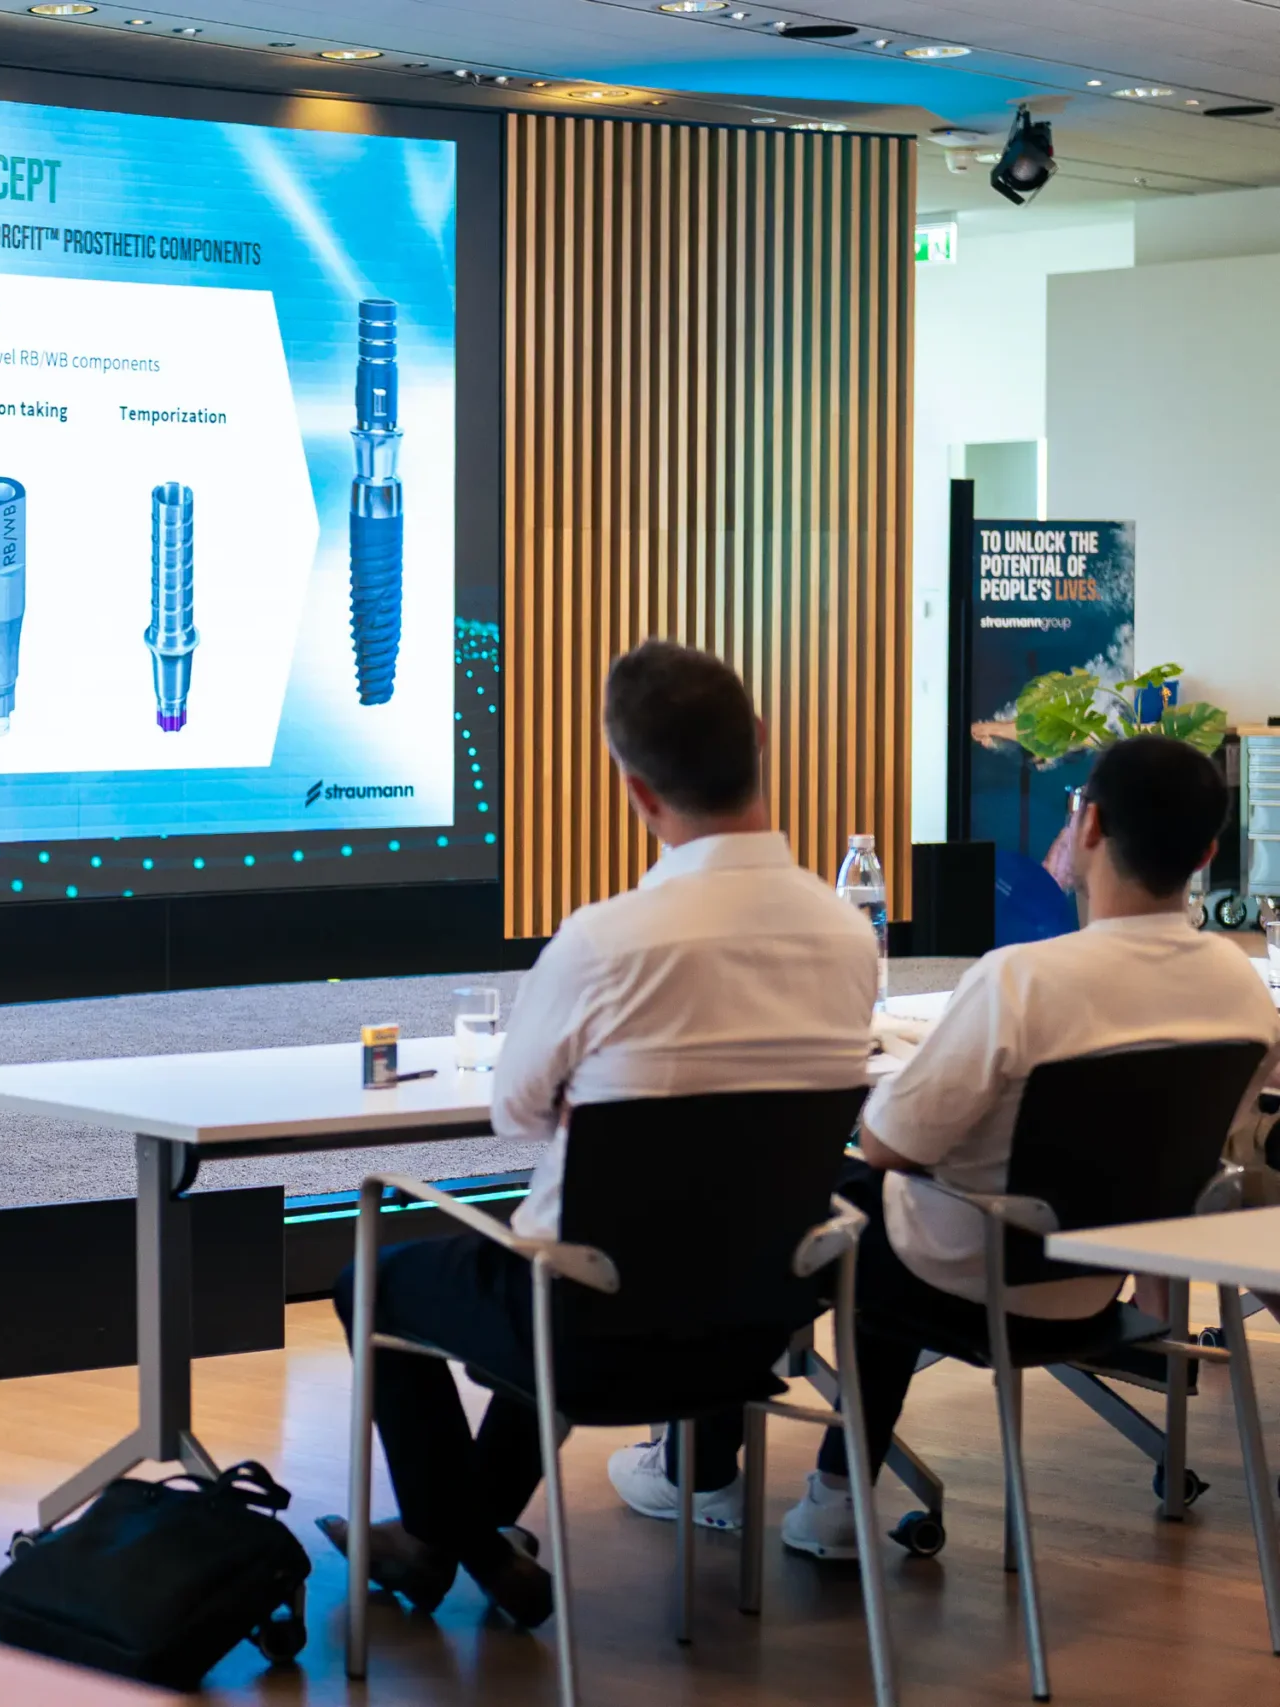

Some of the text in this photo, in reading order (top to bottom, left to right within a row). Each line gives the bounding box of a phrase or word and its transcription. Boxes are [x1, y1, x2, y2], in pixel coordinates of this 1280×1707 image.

[63, 229, 156, 260] PROSTHETIC
[160, 237, 262, 266] COMPONENTS
[20, 349, 69, 369] RB/WB
[72, 354, 161, 374] components
[20, 401, 69, 423] taking
[119, 404, 227, 426] Temporization
[3, 504, 18, 567] RB/WB
[980, 530, 1099, 553] TO UNLOCK THE
[980, 554, 1087, 577] POTENTIAL OF
[980, 578, 1052, 601] PEOPLE'S
[324, 784, 415, 800] straumann
